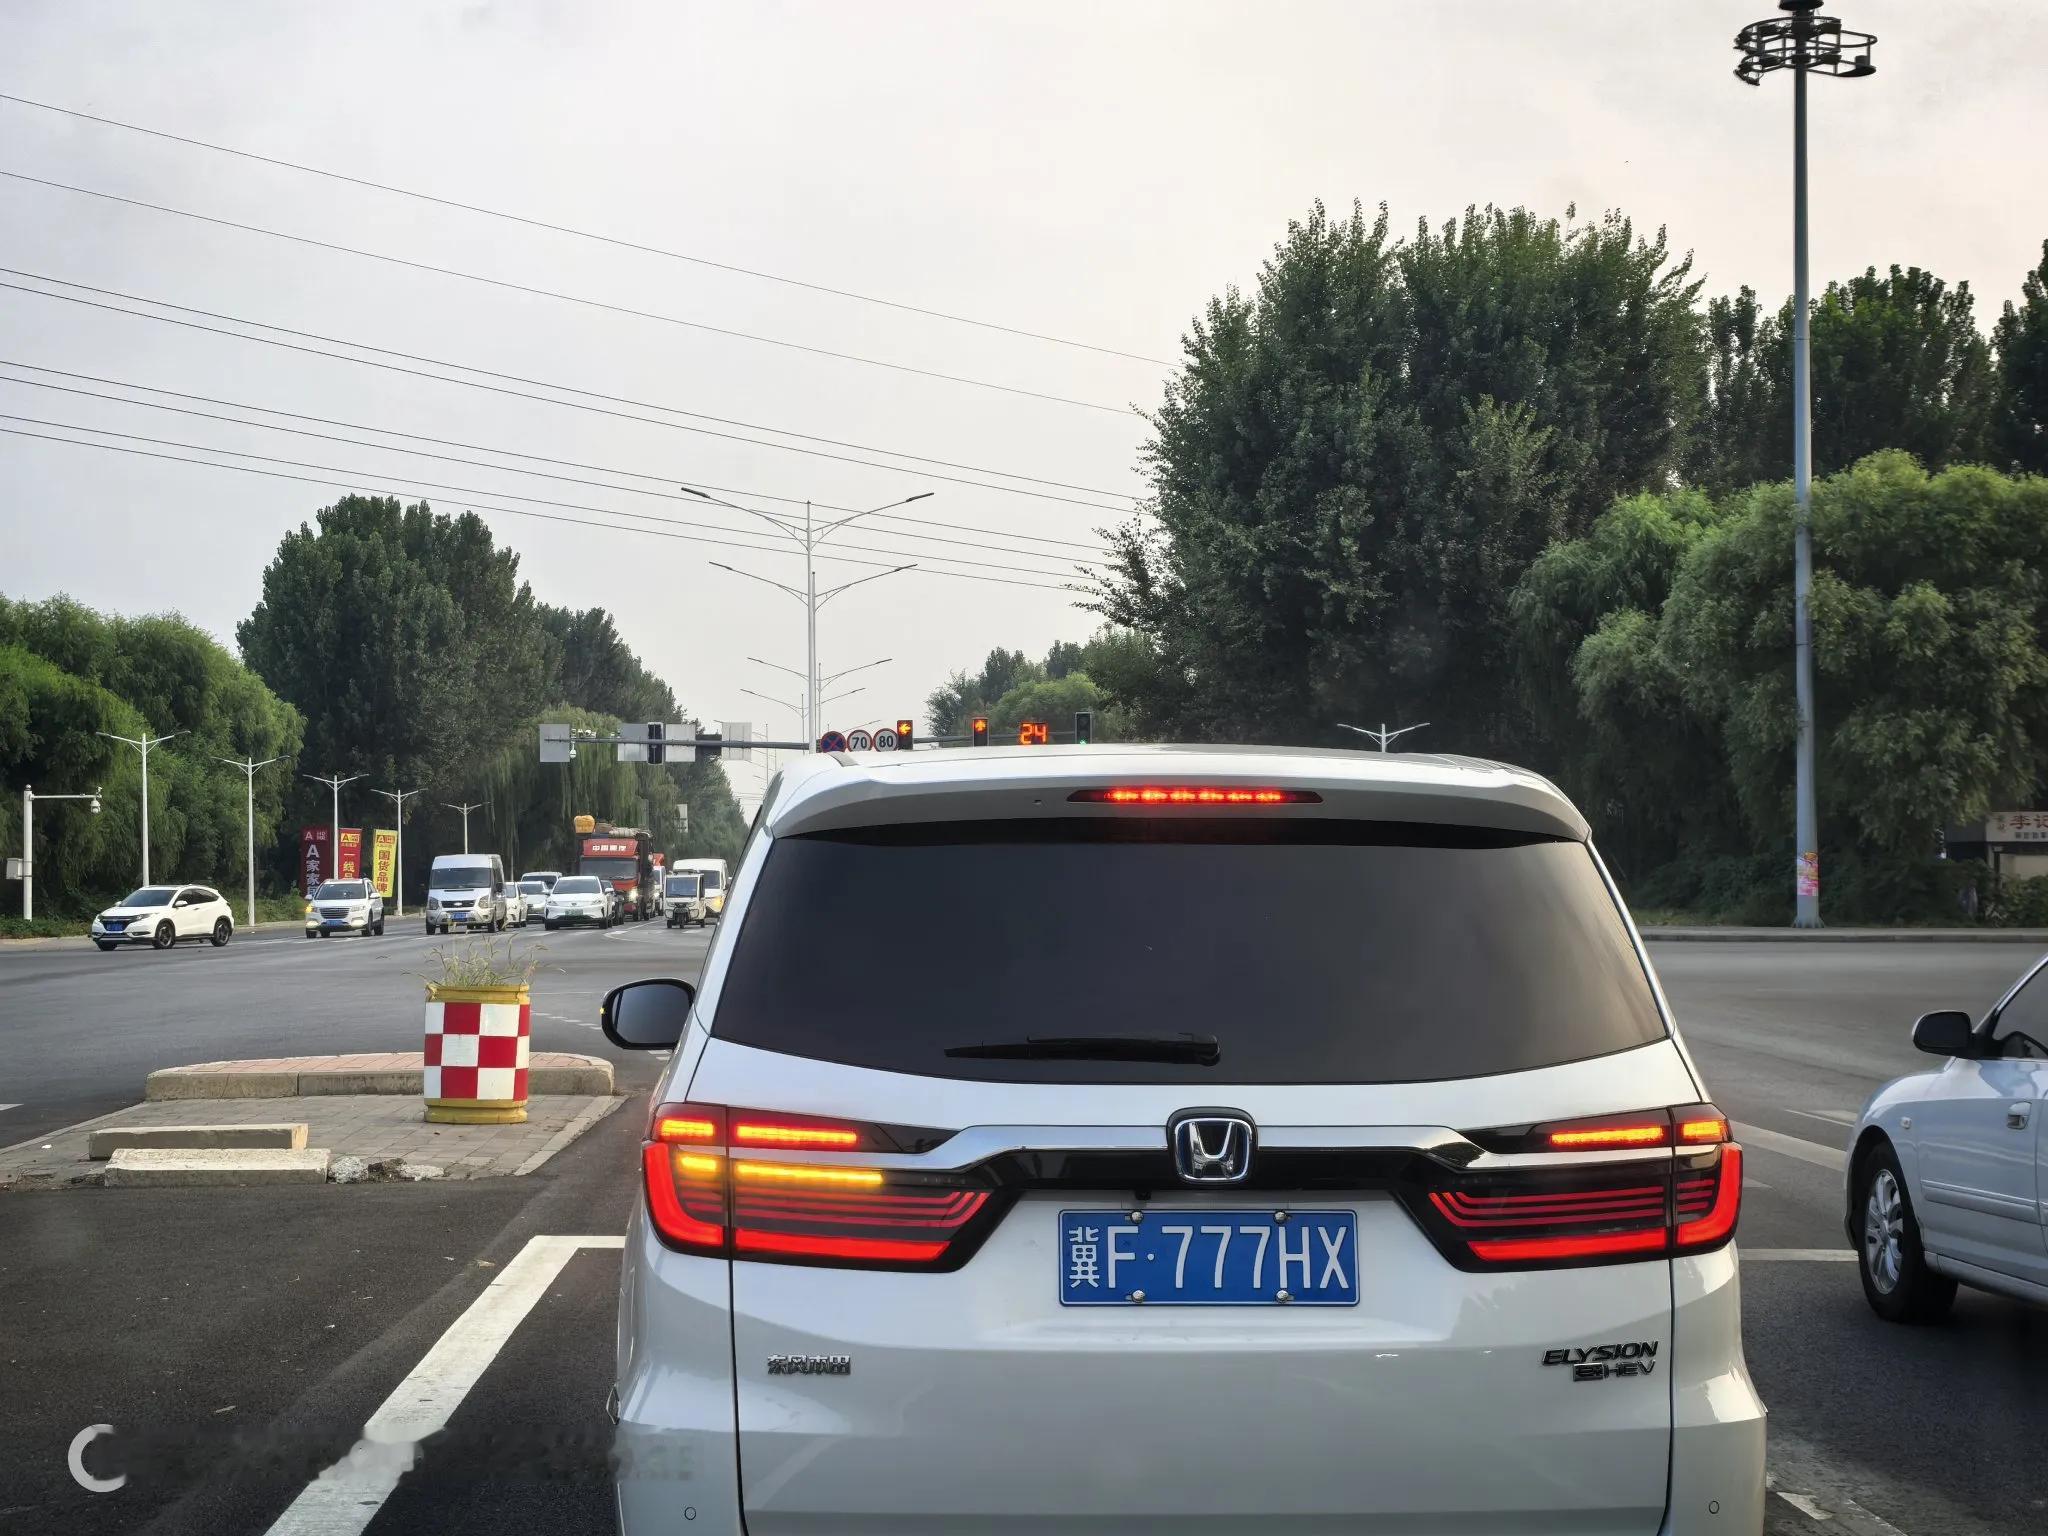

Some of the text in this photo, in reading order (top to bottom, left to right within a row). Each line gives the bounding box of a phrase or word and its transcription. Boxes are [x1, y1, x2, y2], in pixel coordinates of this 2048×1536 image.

[852, 736, 867, 749] 70
[879, 735, 893, 748] 80
[1021, 723, 1047, 745] 24
[1542, 1340, 1658, 1366] ELYSION
